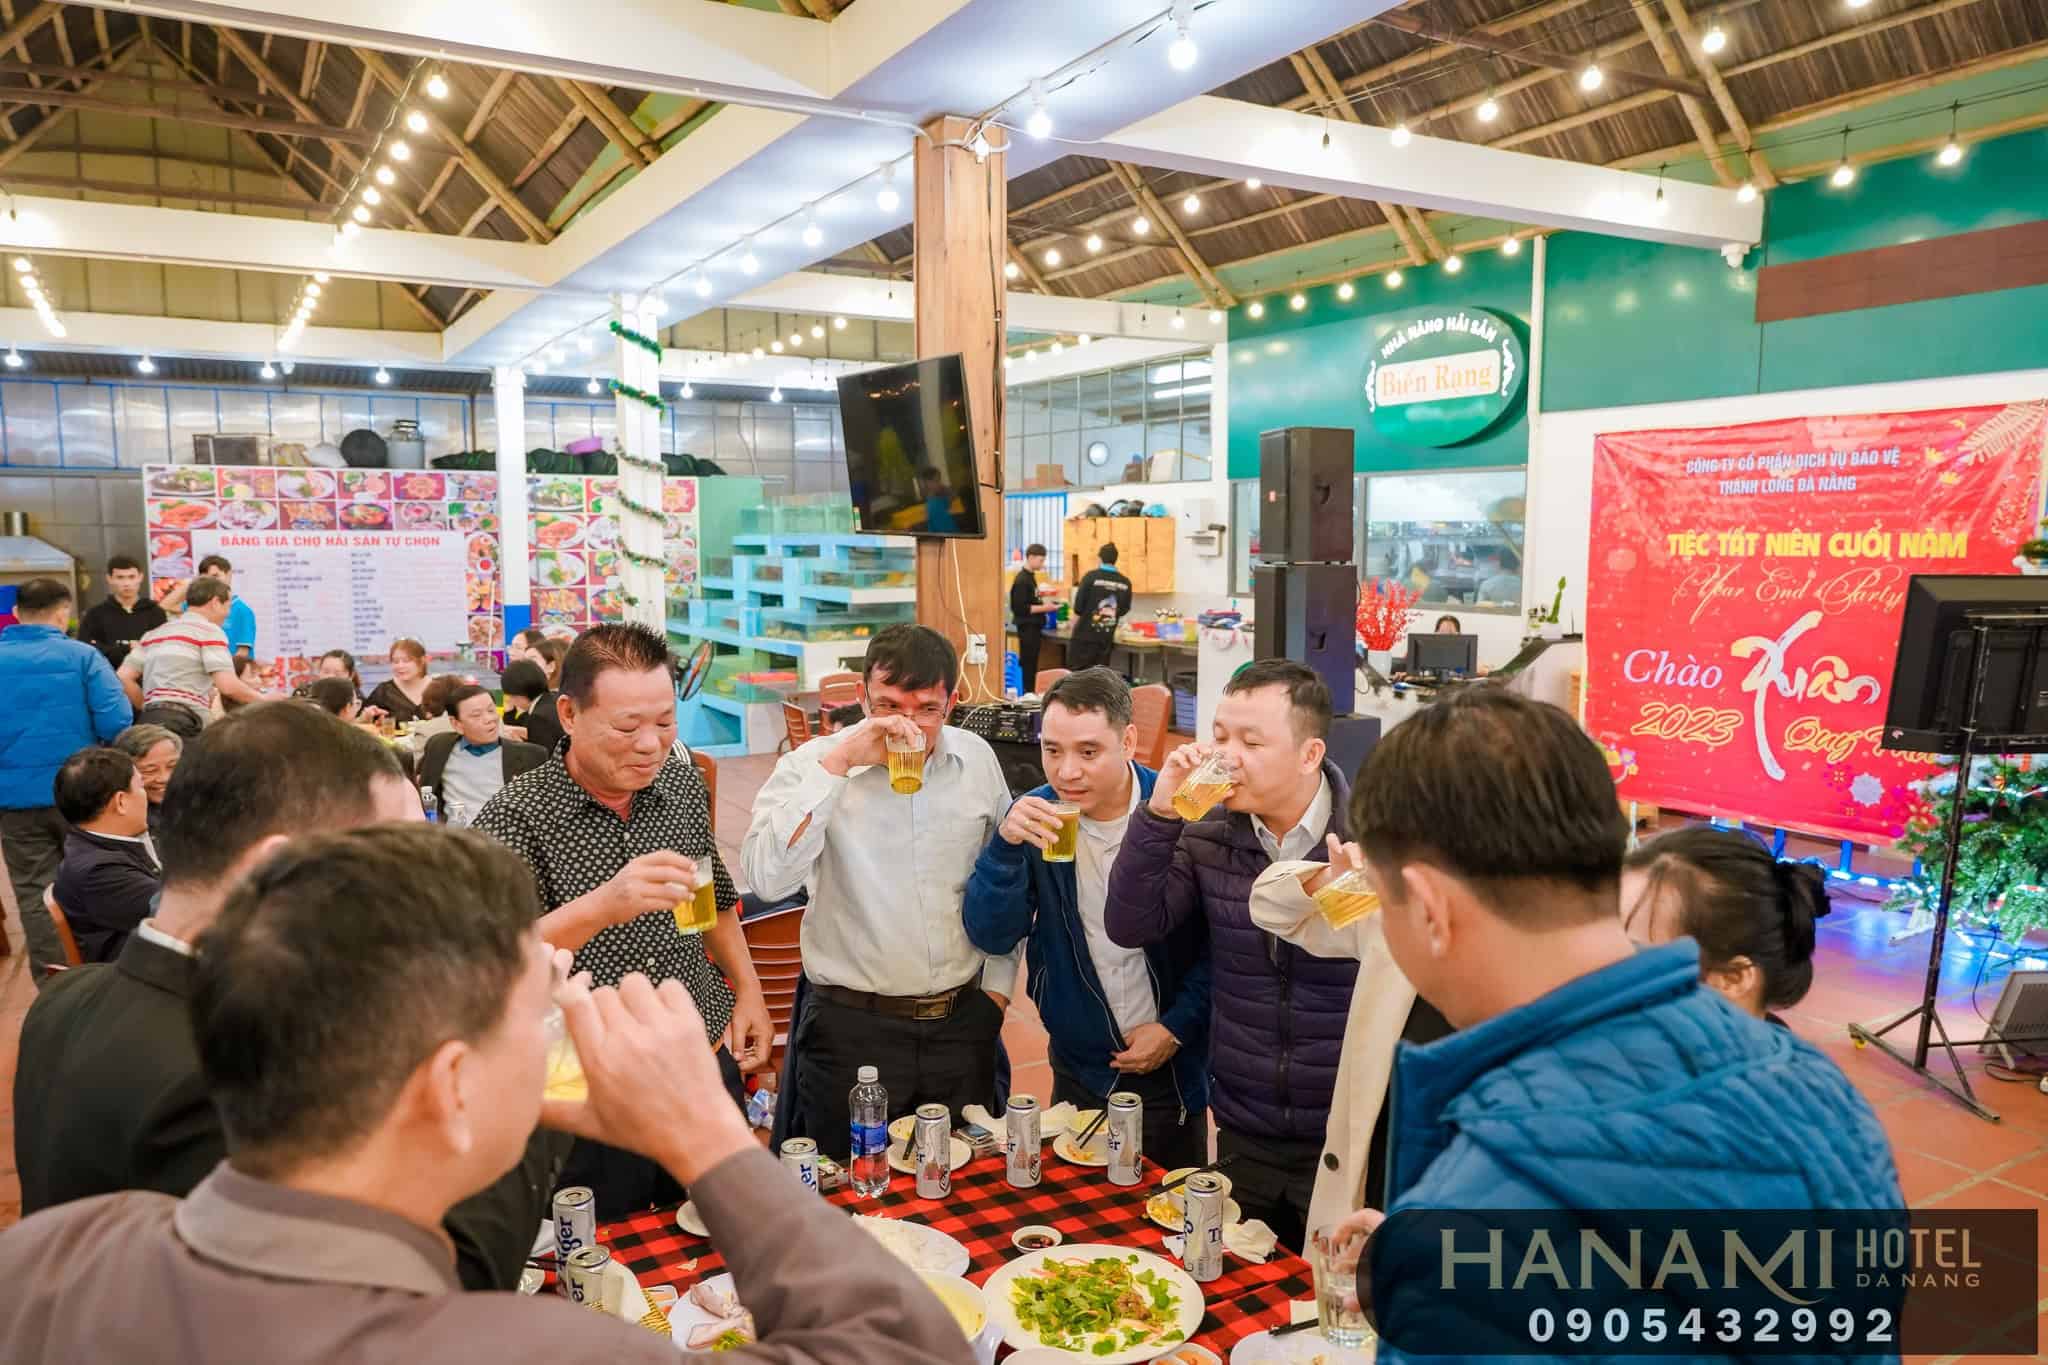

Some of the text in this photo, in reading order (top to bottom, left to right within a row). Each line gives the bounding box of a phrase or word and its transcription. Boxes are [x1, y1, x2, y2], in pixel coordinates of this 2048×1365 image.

[1721, 457, 1735, 471] TY
[1830, 450, 1846, 469] VỤ
[1761, 478, 1794, 494] LONG
[1667, 529, 1711, 561] TIỆC
[1765, 528, 1821, 557] NIÊN
[1672, 559, 1904, 625] Year End Party
[1623, 610, 1881, 781] Chào Xuân
[1630, 702, 1744, 746] 2023
